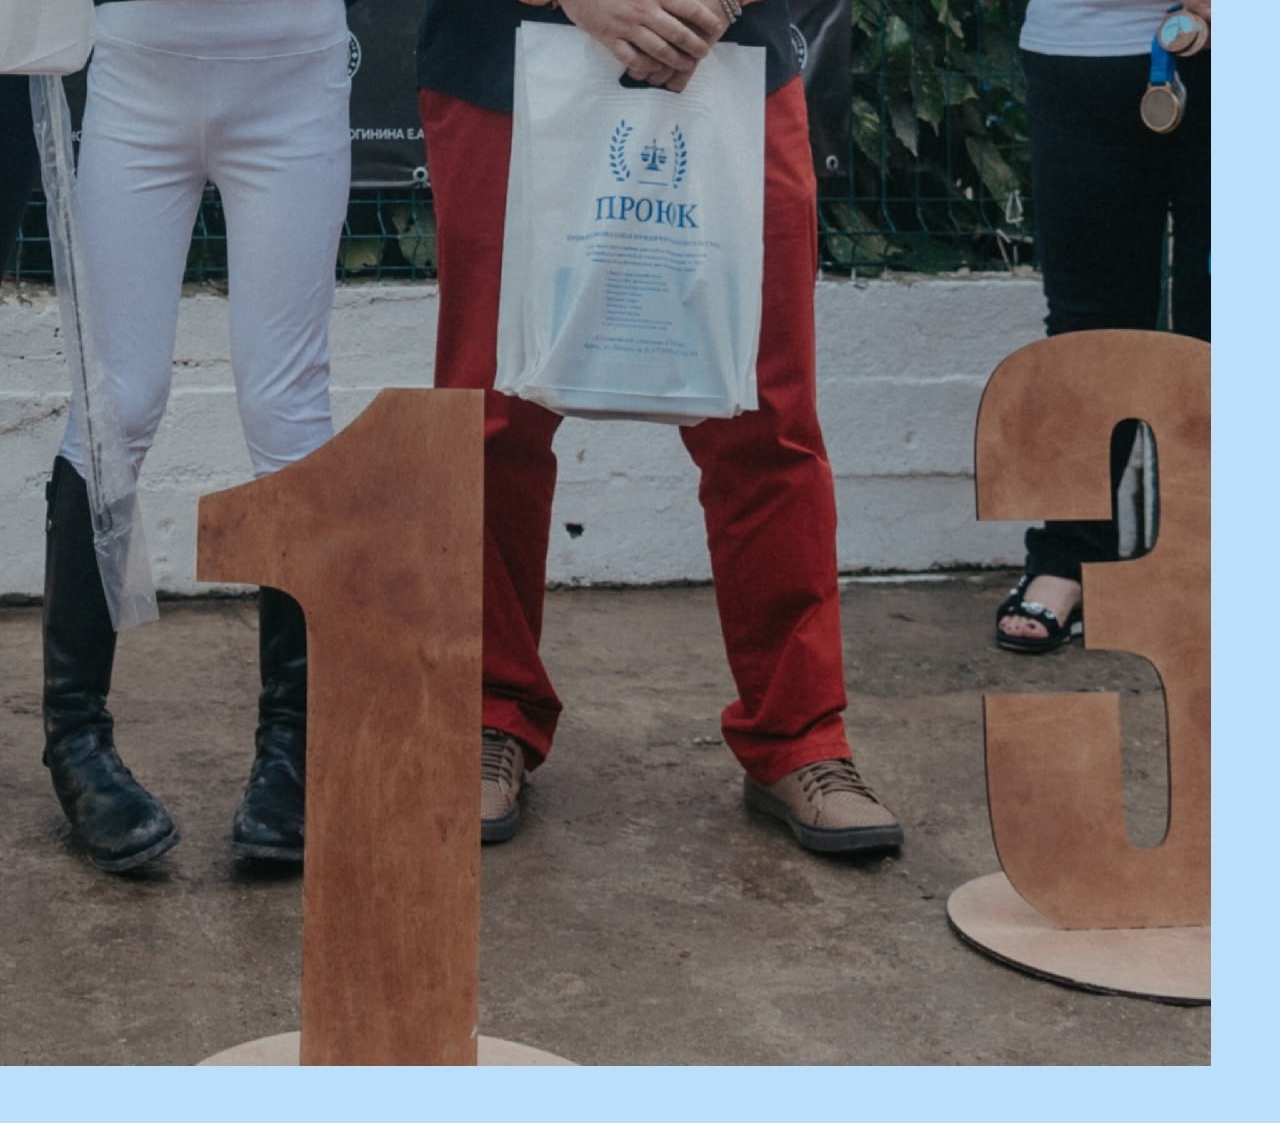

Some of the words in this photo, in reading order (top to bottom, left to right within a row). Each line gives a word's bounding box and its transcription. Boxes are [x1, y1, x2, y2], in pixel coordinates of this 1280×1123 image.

[595, 195, 699, 229] ПРОЮК
[197, 388, 484, 1066] 1
[975, 328, 1211, 930] 3
